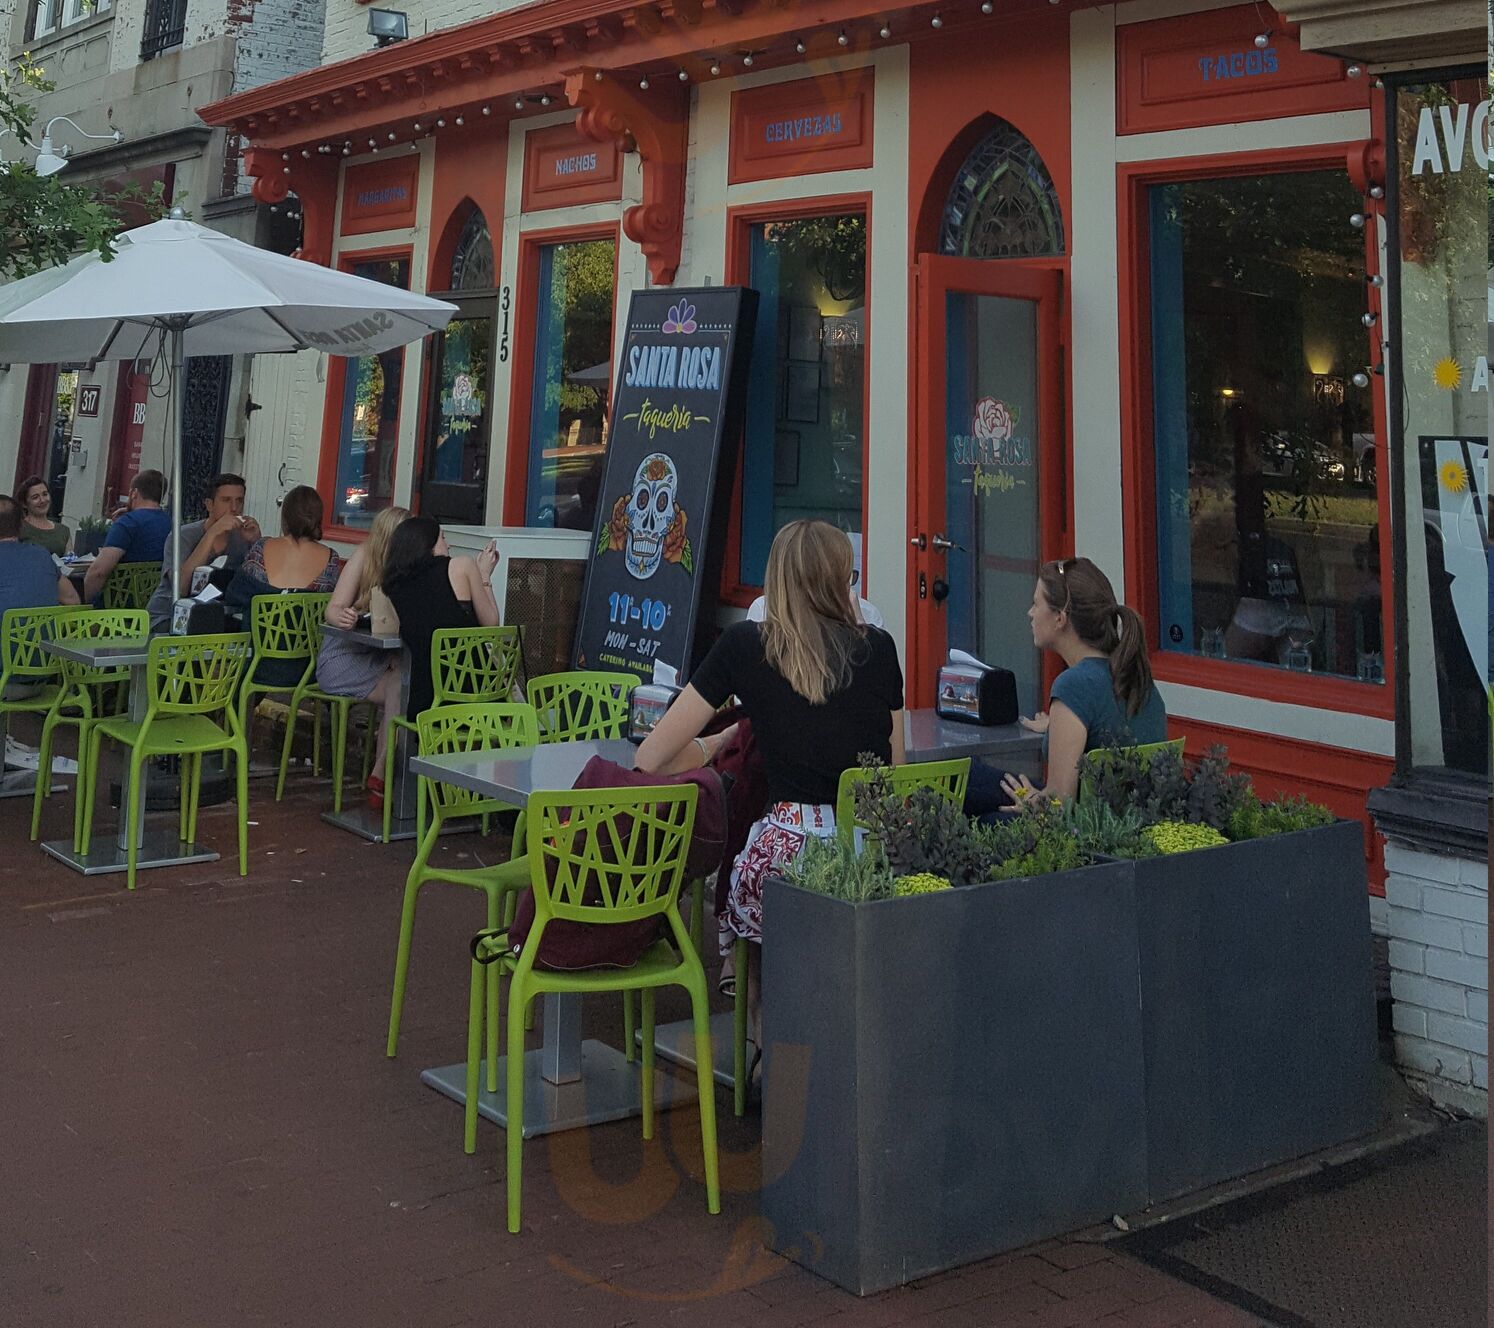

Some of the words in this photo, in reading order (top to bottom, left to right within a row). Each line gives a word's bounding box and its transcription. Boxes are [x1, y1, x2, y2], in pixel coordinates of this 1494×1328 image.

[1199, 47, 1279, 81] TACOS
[765, 112, 843, 144] CERVEZAS
[555, 153, 597, 176] NACHOS
[500, 286, 510, 362] 315
[625, 345, 677, 389] SANTA
[677, 346, 722, 390] ROSA
[81, 390, 98, 412] 317
[637, 397, 692, 439] taqueria
[953, 434, 996, 465] SANTA
[999, 435, 1032, 465] ROSA
